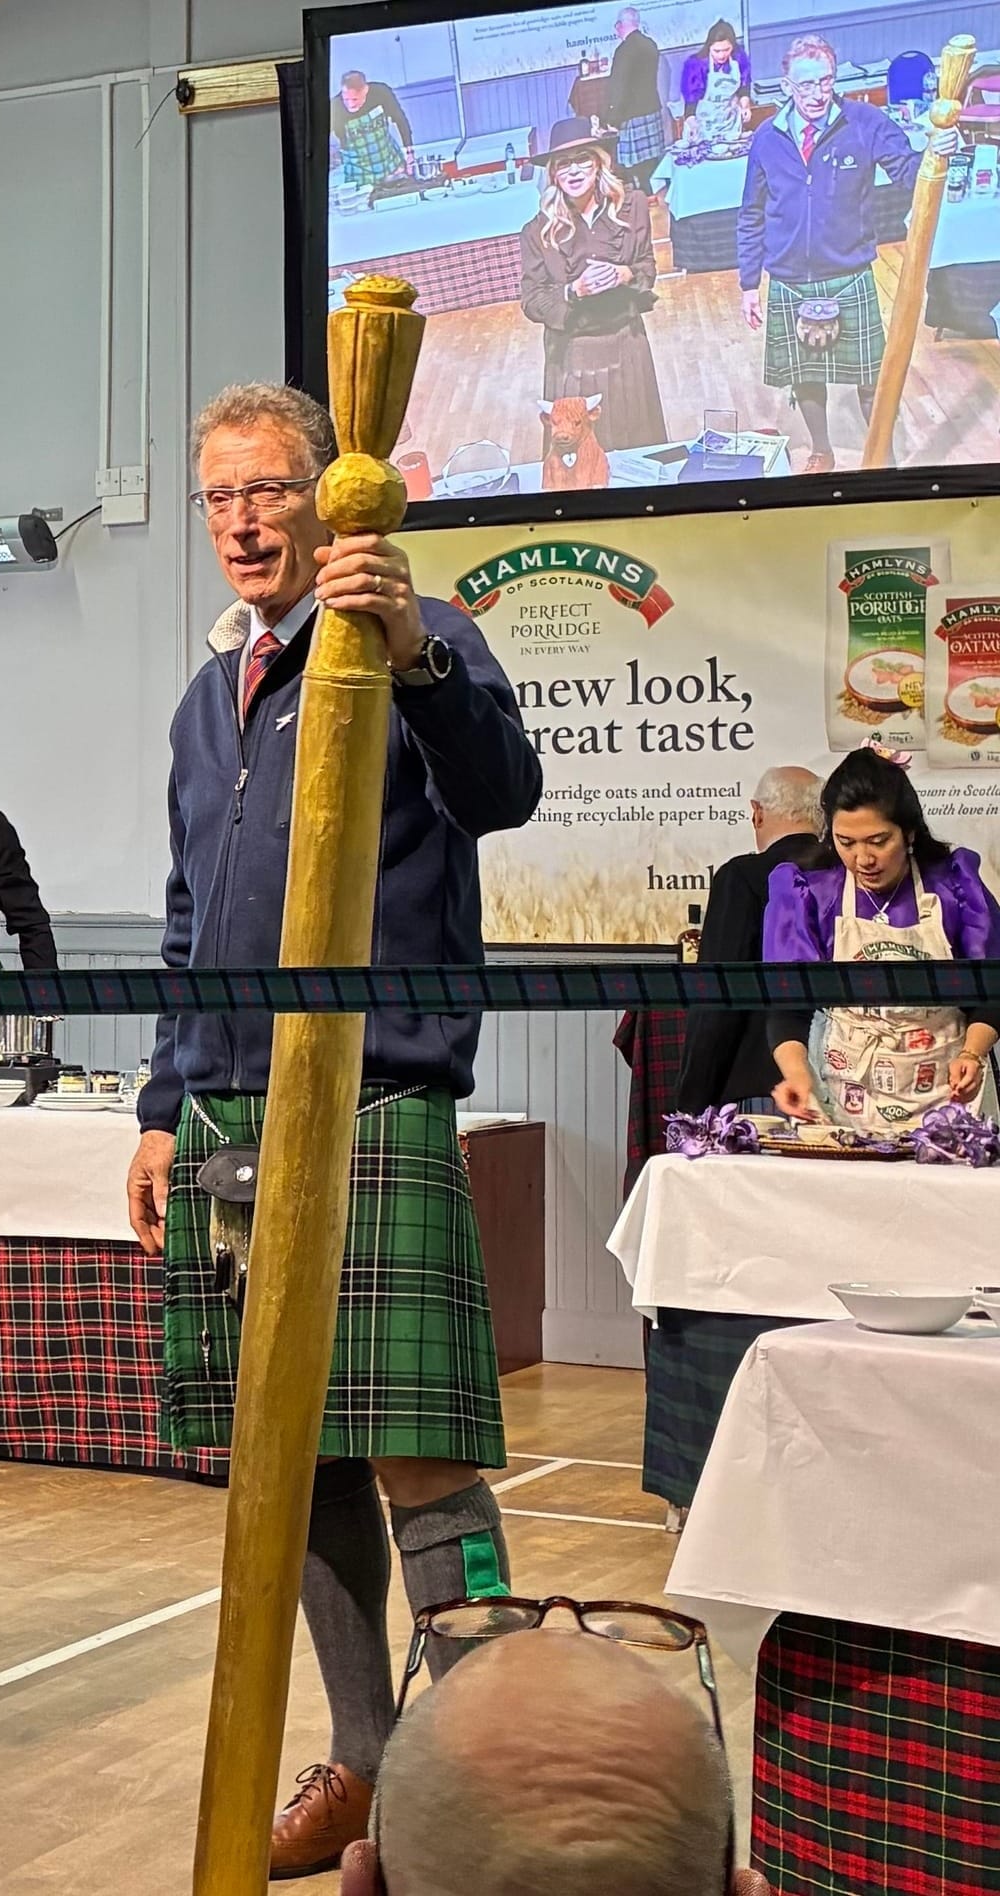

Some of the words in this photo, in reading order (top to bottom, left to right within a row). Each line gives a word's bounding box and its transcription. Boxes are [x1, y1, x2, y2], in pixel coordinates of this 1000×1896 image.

[467, 547, 643, 594] HAMLYNS
[850, 558, 927, 579] HAMLYNS
[529, 576, 603, 591] SCOTLAND
[863, 591, 912, 601] SCOTTISH
[519, 602, 592, 620] PERFECT
[947, 605, 1000, 626] HAMLY
[511, 622, 601, 639] PORRIDGE
[520, 646, 532, 656] IN
[534, 645, 565, 655] EVERY
[566, 644, 591, 654] WAY
[950, 640, 1000, 653] OATM
[516, 677, 616, 708] new
[625, 655, 753, 713] look,
[525, 719, 623, 755] reat
[636, 716, 755, 753] taste
[605, 786, 638, 799] oats
[641, 782, 672, 799] and
[676, 781, 742, 798] oatmeal
[948, 784, 961, 797] in
[963, 783, 1000, 797] Scotla
[530, 807, 573, 827] ching
[576, 805, 655, 825] recyclable
[658, 809, 705, 826] paper
[708, 804, 750, 826] bags.
[927, 803, 956, 816] with
[957, 802, 984, 816] love
[985, 803, 998, 815] in
[647, 864, 714, 890] haml
